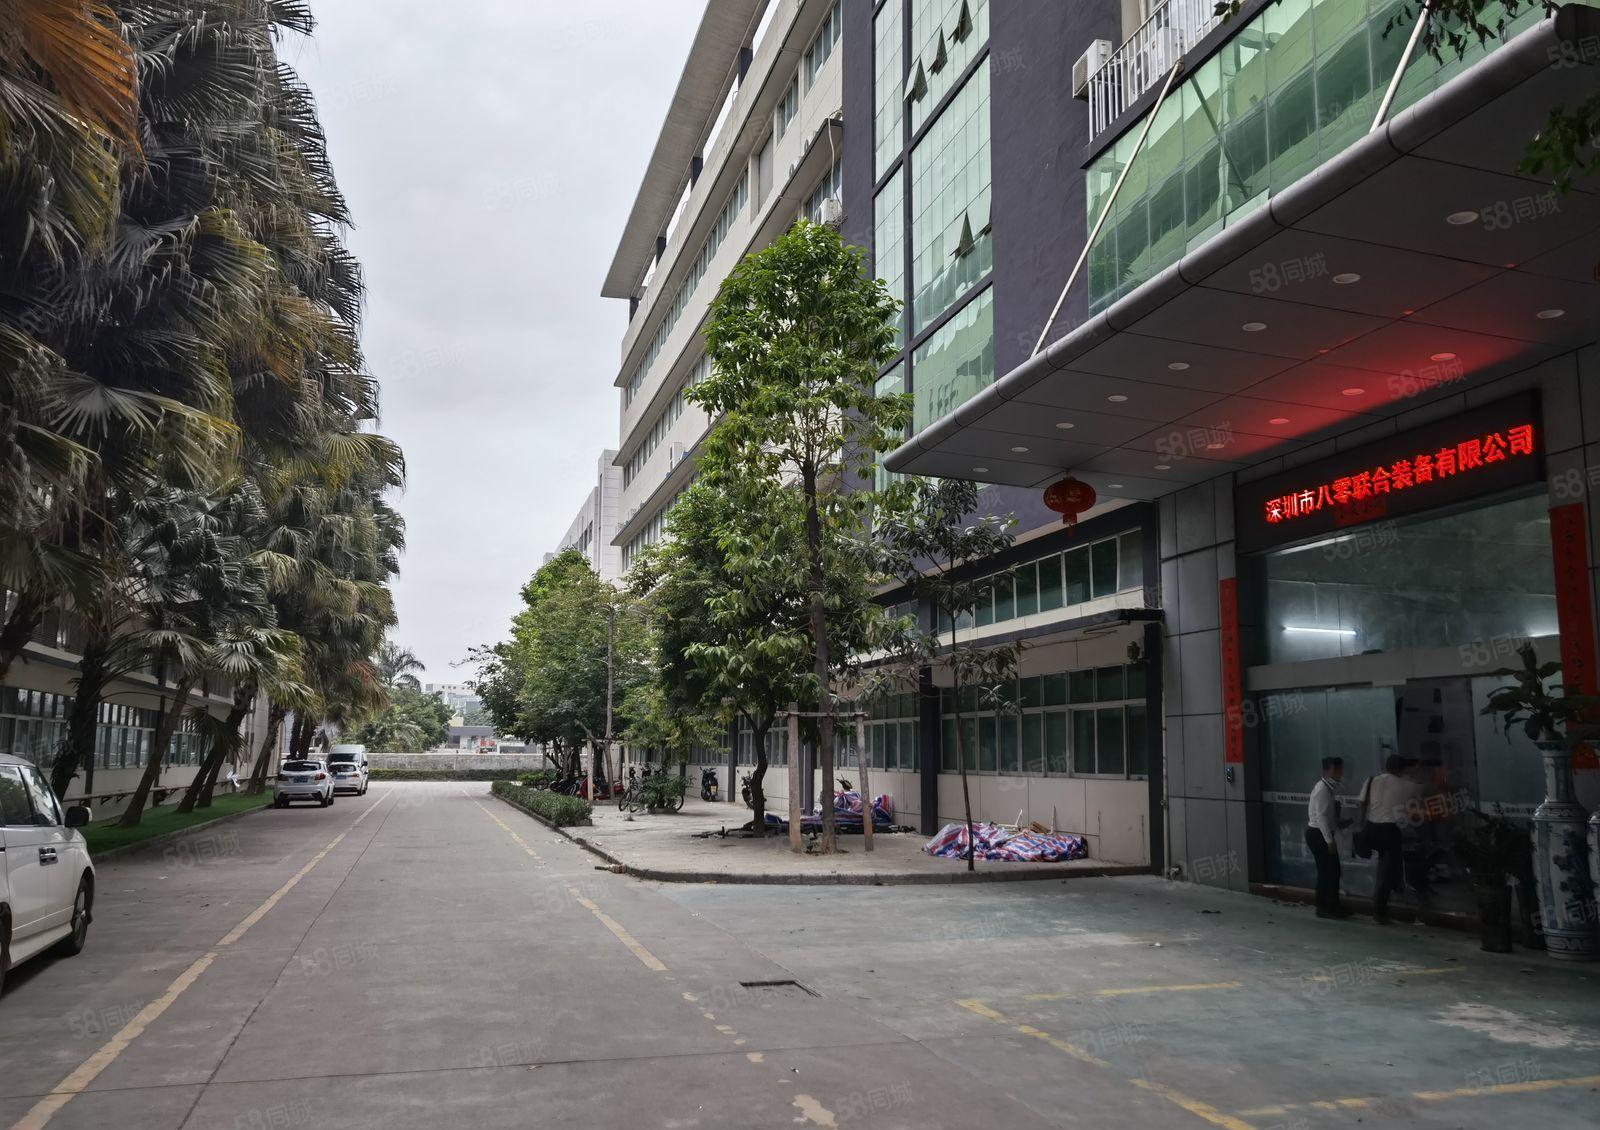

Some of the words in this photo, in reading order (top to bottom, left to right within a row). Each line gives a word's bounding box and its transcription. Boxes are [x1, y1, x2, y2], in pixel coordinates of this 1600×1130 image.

[1264, 424, 1535, 524] 深圳市八零联合装备有限公司
